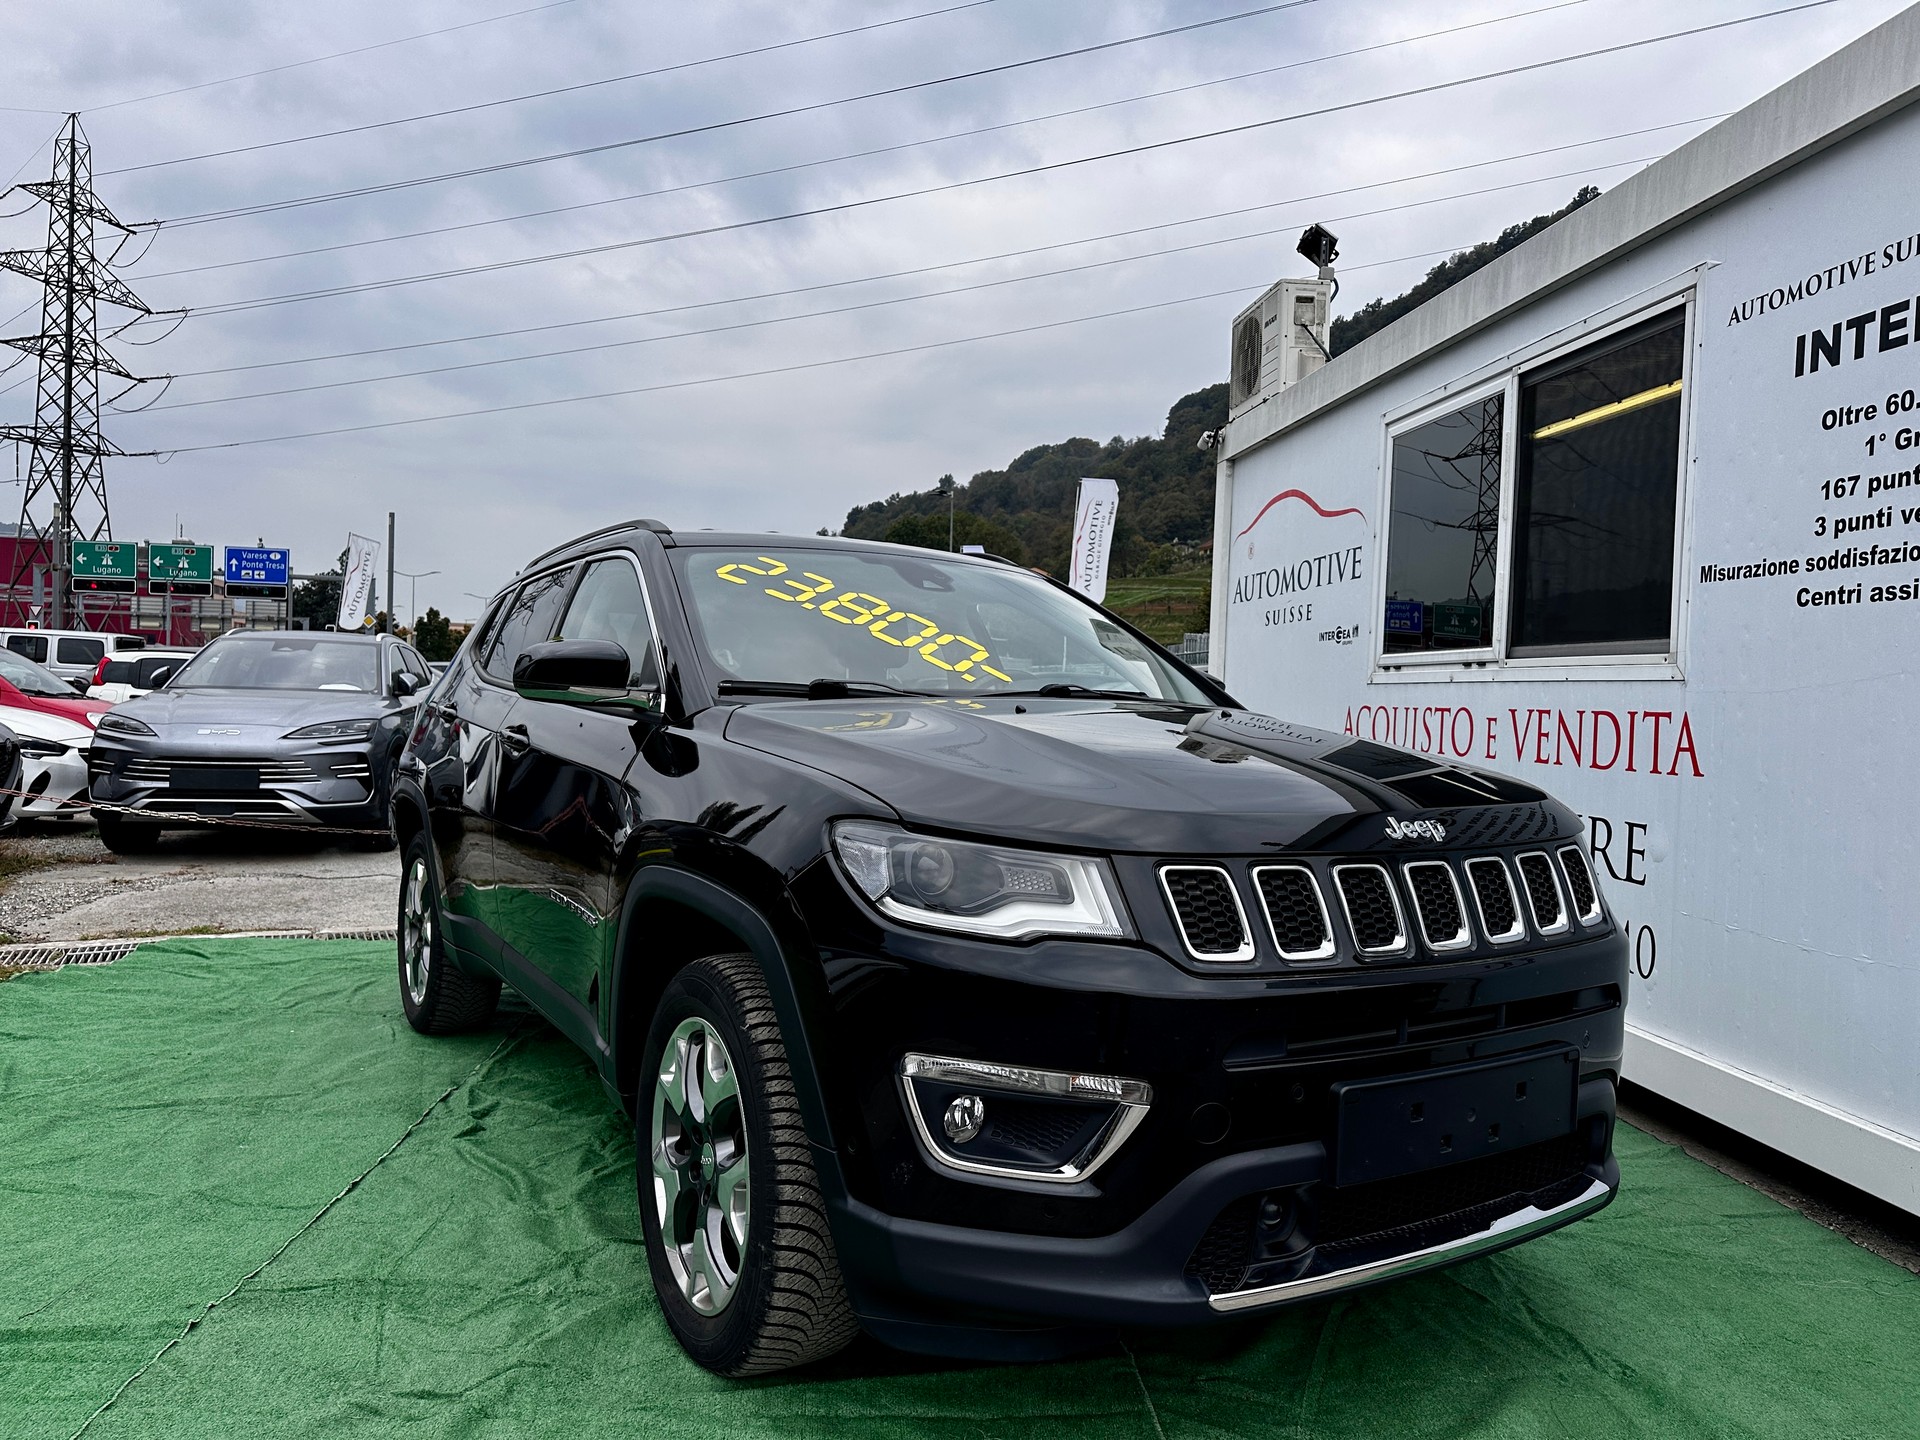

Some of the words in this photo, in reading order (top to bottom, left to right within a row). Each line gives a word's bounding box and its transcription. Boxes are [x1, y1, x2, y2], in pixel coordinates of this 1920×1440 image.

[1727, 250, 1877, 328] AUTOMOTIVE
[1794, 295, 1920, 379] INTE
[1821, 404, 1878, 431] Oltre
[1885, 389, 1920, 416] 60.
[1820, 475, 1861, 500] 167
[1813, 516, 1827, 537] 3
[1833, 505, 1893, 539] punti
[242, 551, 268, 560] Varese
[1084, 499, 1104, 592] AUTOMOTIVE
[1699, 558, 1800, 584] Misurazione
[1805, 541, 1920, 573] soddisfazio
[92, 565, 122, 575] Lugano
[169, 568, 198, 577] Lugano
[241, 560, 264, 569] Ponte
[265, 561, 285, 570] Tresa
[1233, 545, 1363, 605] AUTOMOTIVE
[347, 550, 372, 620] AUTOMOTIVE
[1796, 582, 1863, 608] Centri
[1869, 577, 1920, 603] assi
[1264, 603, 1313, 627] SUISSE
[1343, 705, 1475, 757] ACQUISTO
[1485, 717, 1498, 760] E
[1508, 708, 1705, 778] VENDITA
[1384, 816, 1447, 843] Jeep
[1578, 814, 1648, 886] RE
